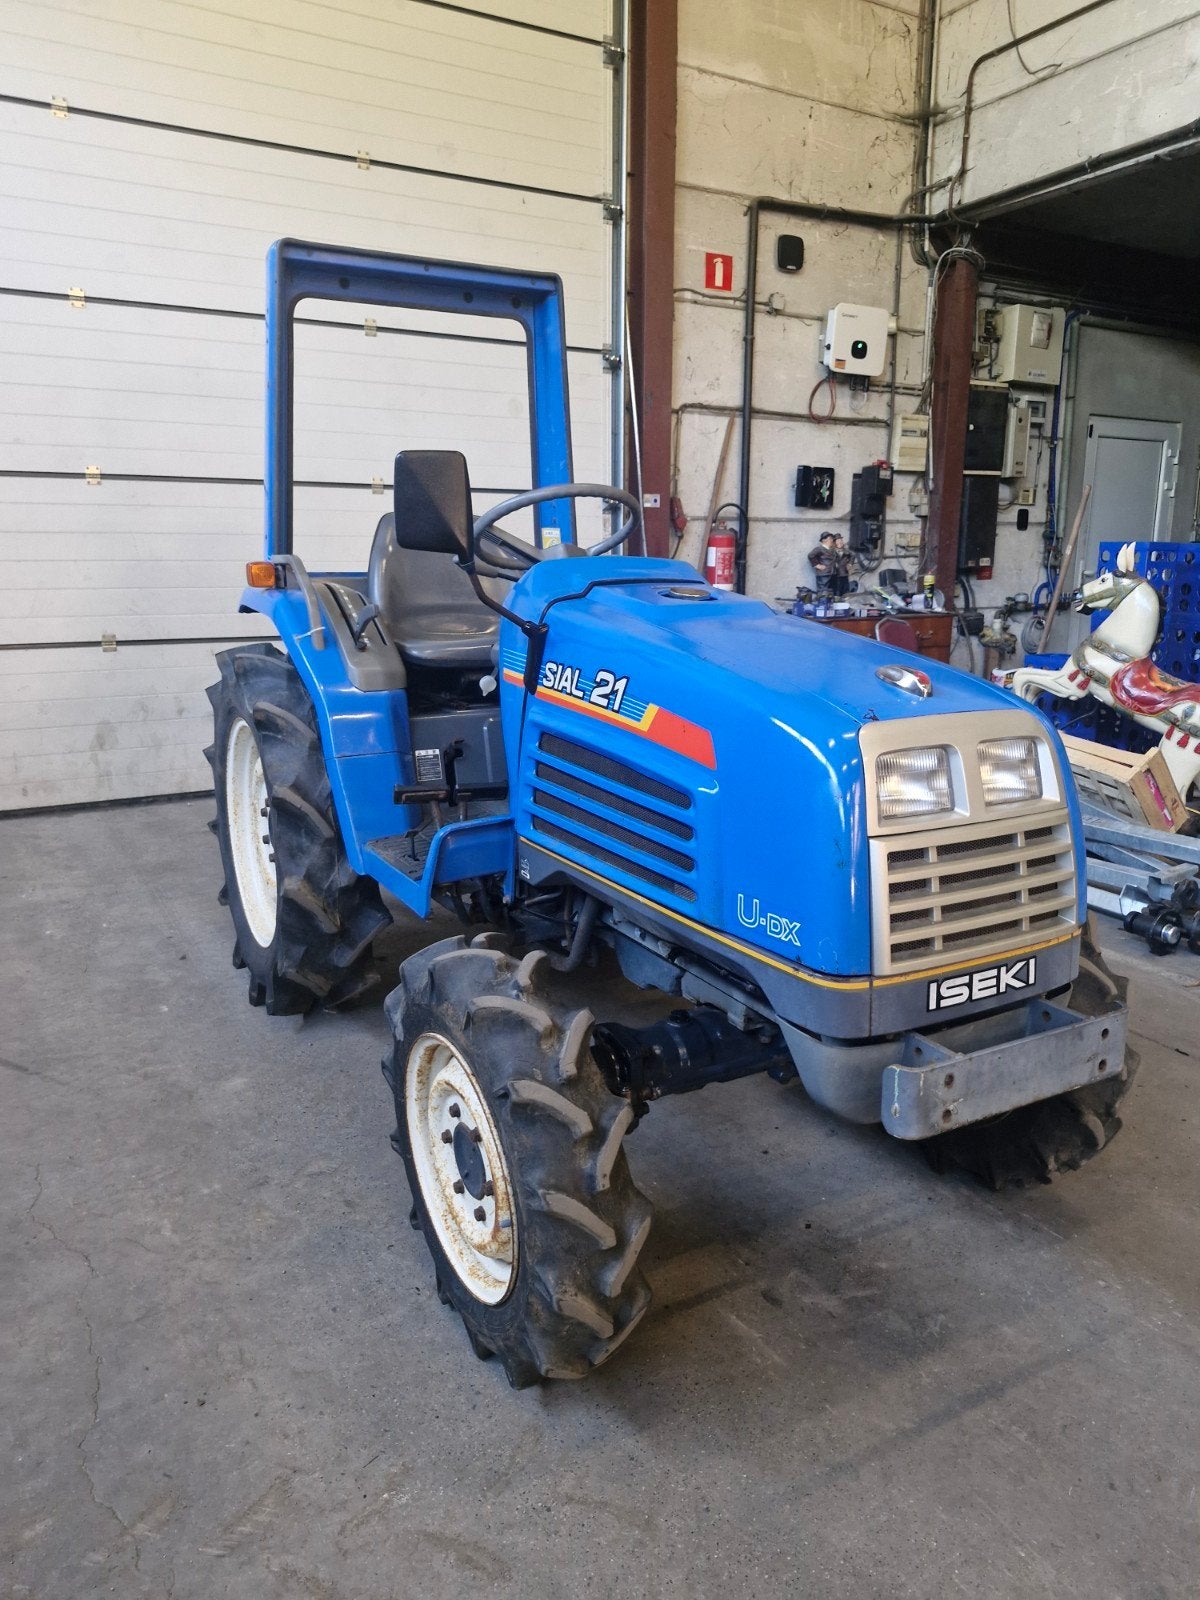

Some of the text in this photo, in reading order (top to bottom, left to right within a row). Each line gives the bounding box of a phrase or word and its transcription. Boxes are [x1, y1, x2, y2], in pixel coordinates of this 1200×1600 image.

[542, 661, 629, 713] SIAL 21
[927, 957, 1036, 1011] ISEKI
